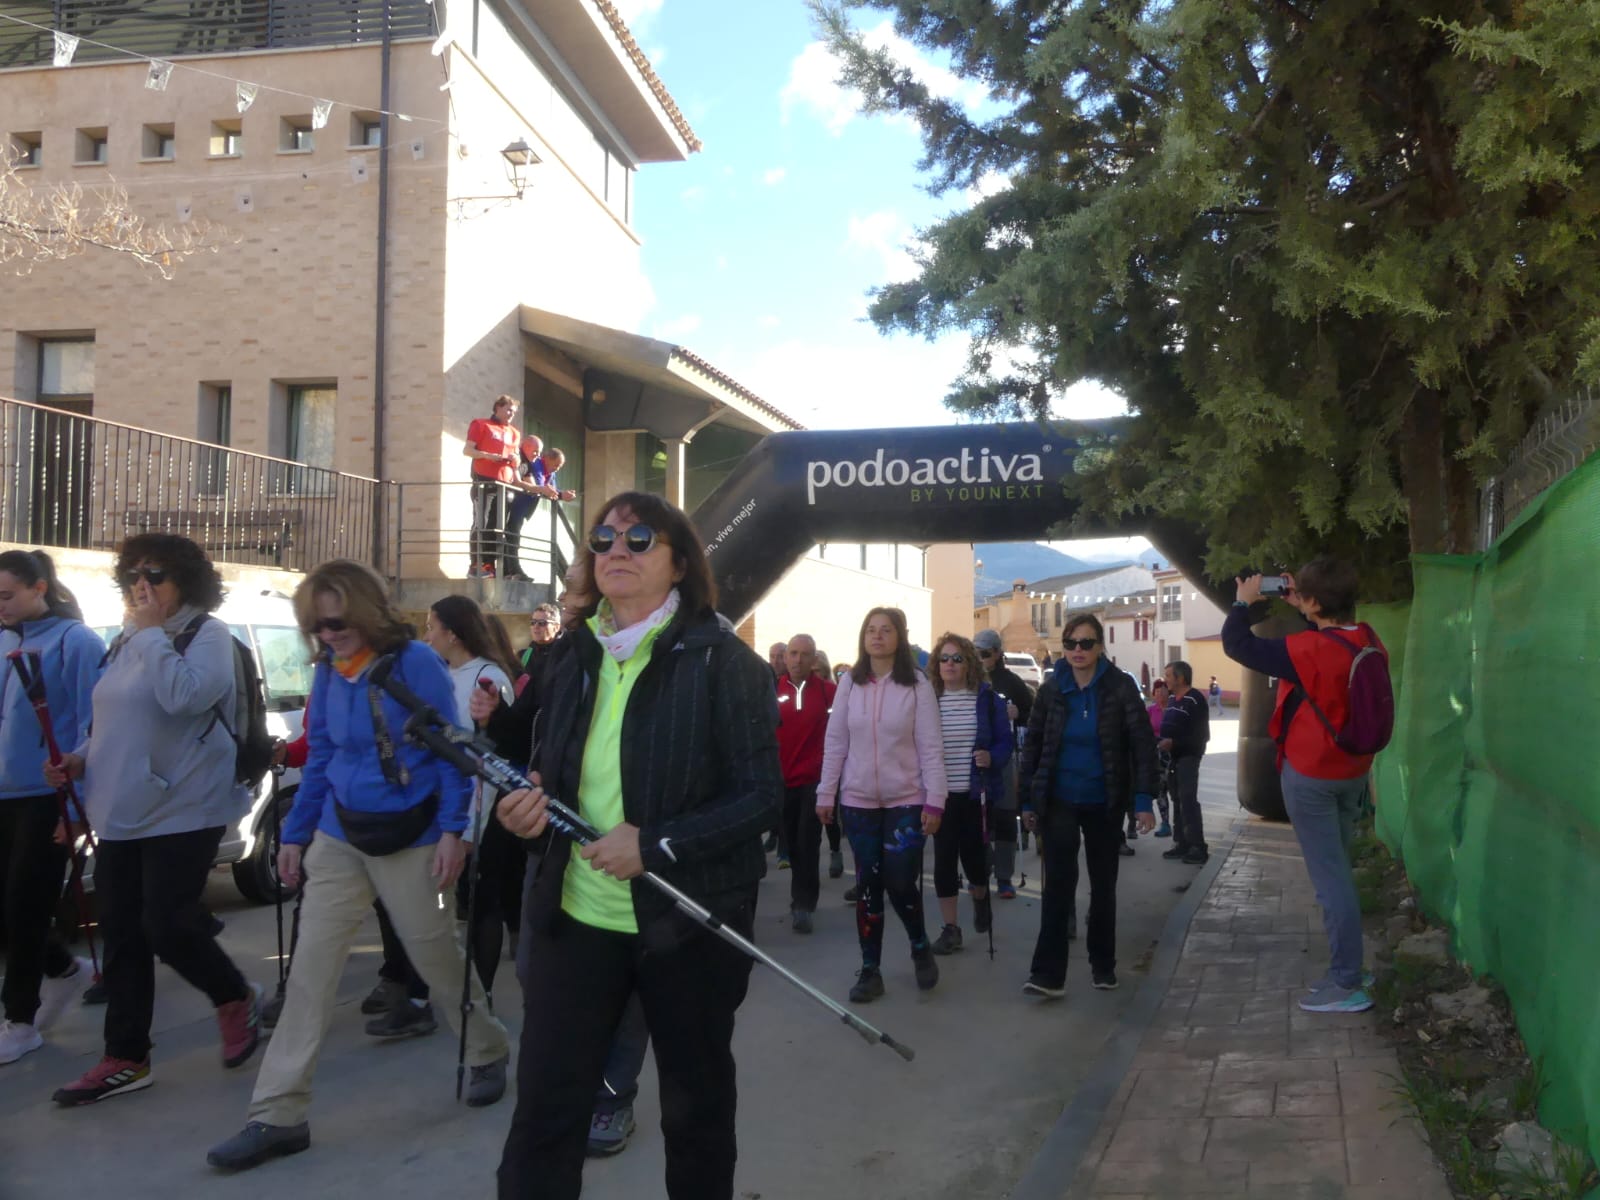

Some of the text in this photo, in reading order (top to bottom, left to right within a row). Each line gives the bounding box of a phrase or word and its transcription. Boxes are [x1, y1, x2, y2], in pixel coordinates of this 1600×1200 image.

[911, 484, 1045, 503] BY YOUNEXT
[715, 525, 734, 543] vive
[732, 498, 757, 526] mejor
